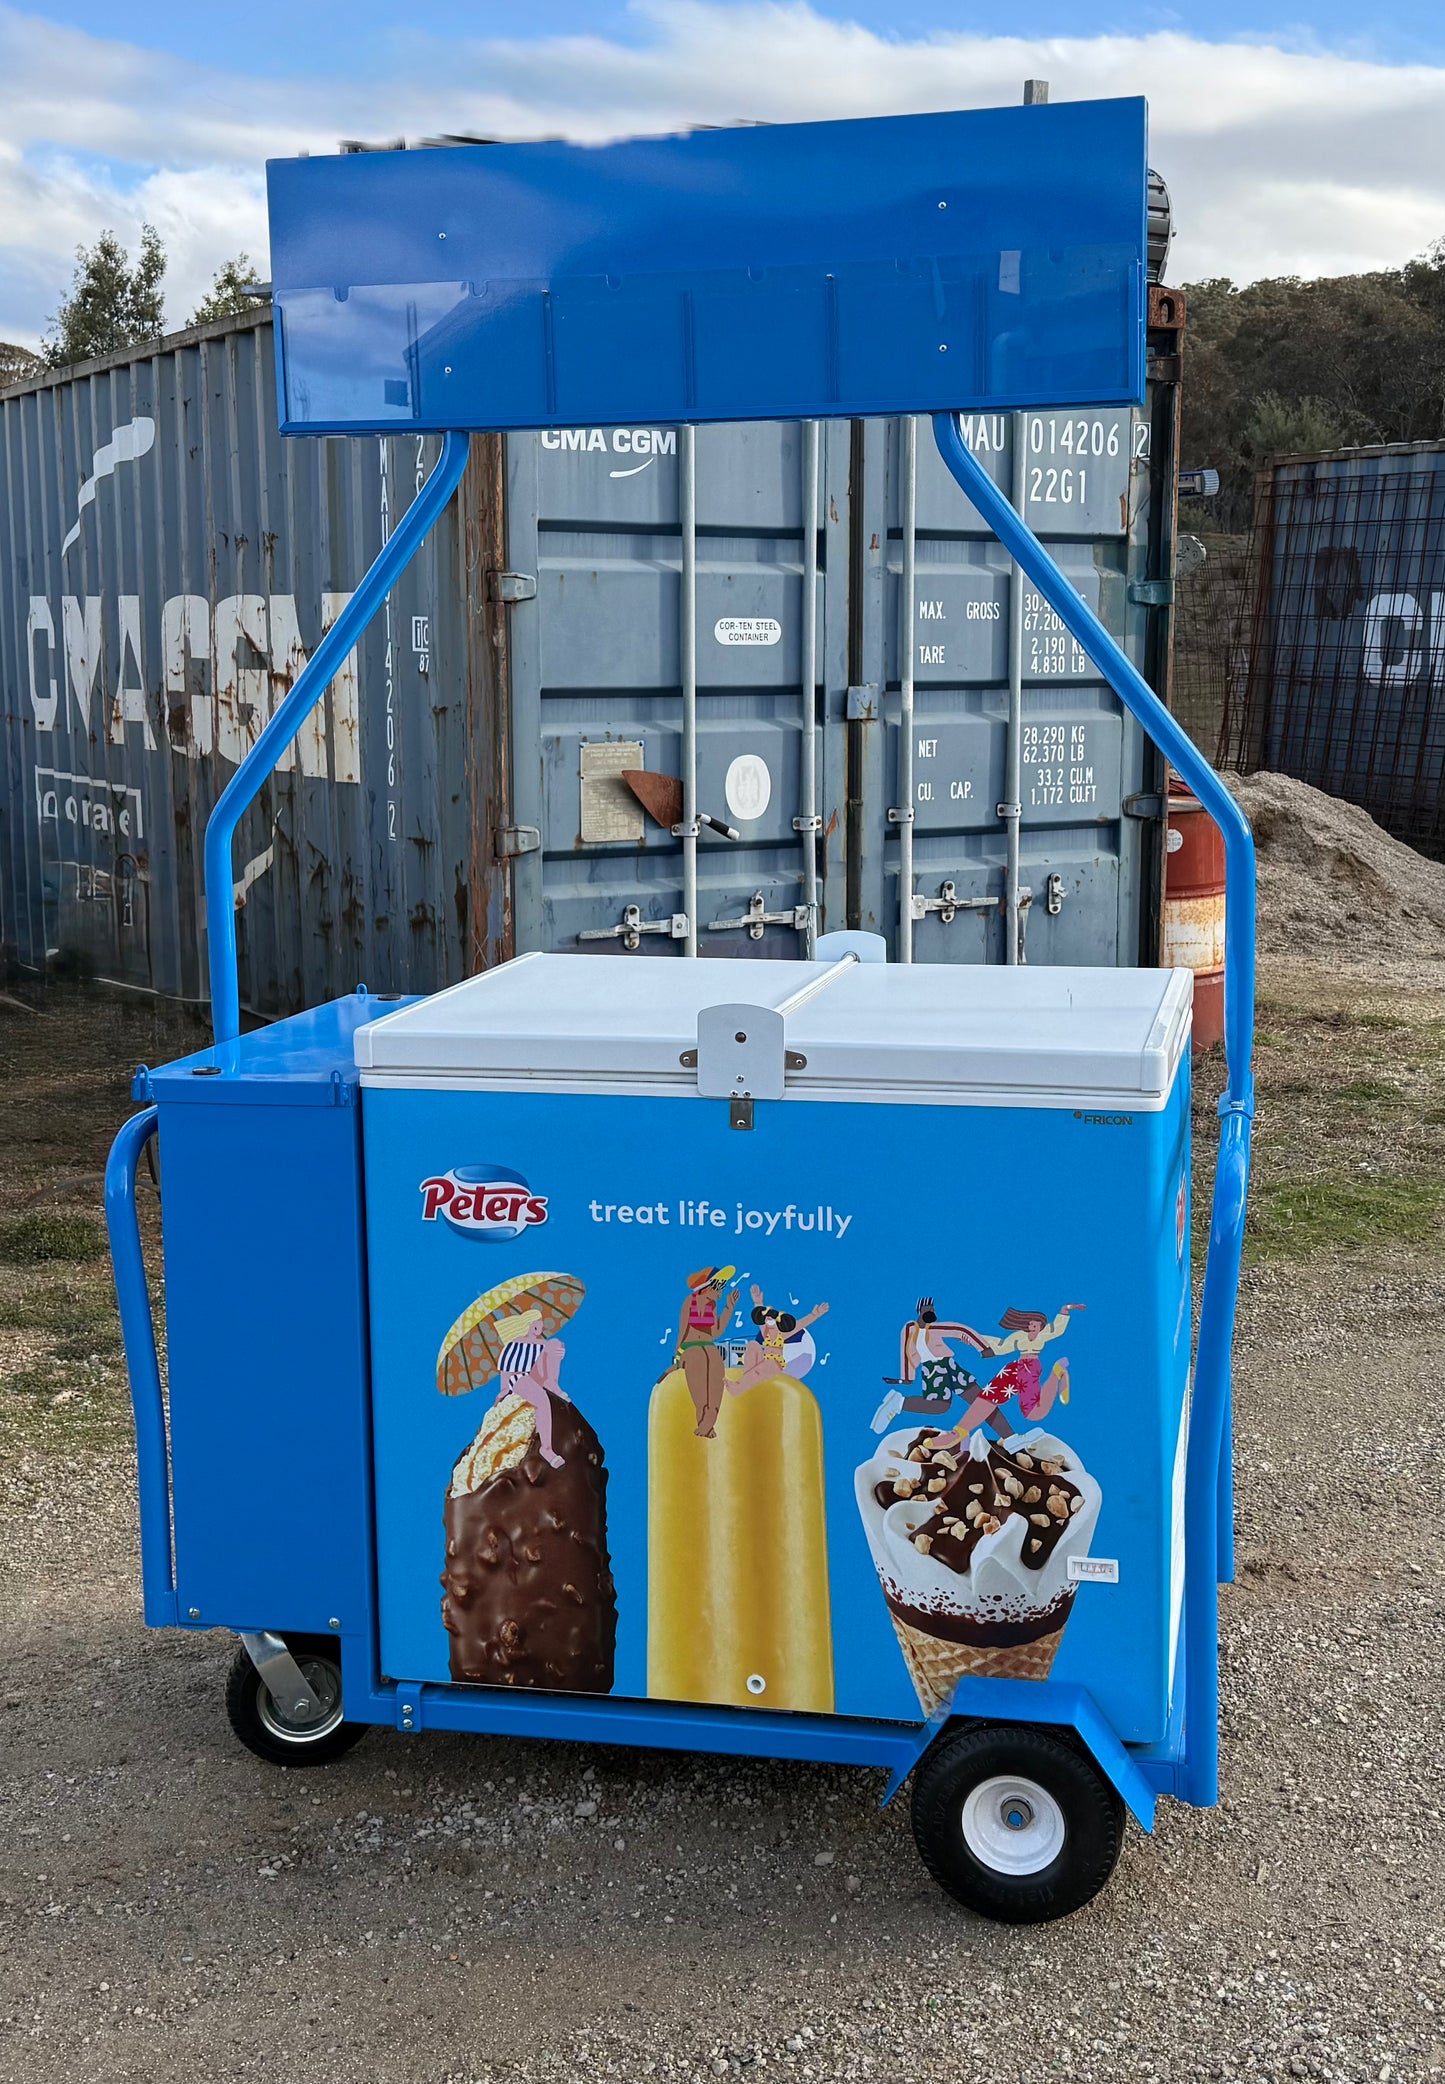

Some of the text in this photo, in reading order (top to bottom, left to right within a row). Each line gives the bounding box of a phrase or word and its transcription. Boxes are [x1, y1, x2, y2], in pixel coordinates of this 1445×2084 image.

[541, 429, 676, 455] CMA CGM
[1031, 418, 1119, 457] 014206
[1135, 424, 1148, 458] 2
[1030, 467, 1086, 503] 22G1
[919, 601, 1000, 620] MAX. GROSS
[719, 621, 777, 631] COR-TEN STEEL
[728, 632, 769, 642] CONTAINER
[1031, 637, 1065, 655] 2,190
[1362, 592, 1445, 688] C
[919, 645, 945, 664] TARE
[27, 595, 157, 751] CMA
[1030, 656, 1085, 674] 4,830 LB
[384, 591, 395, 788] 14206
[1023, 725, 1085, 745] 28,290 KG
[918, 739, 938, 758] NET
[1023, 744, 1085, 763] 62,370 LB
[1037, 766, 1094, 786] 33.2 CU.M
[917, 781, 974, 801] CU. CAP.
[1031, 785, 1097, 805] 1,172 CU.FT
[1084, 1114, 1133, 1126] FRICON
[420, 1177, 548, 1224] Peters
[588, 1200, 853, 1239] treat life joyfully
